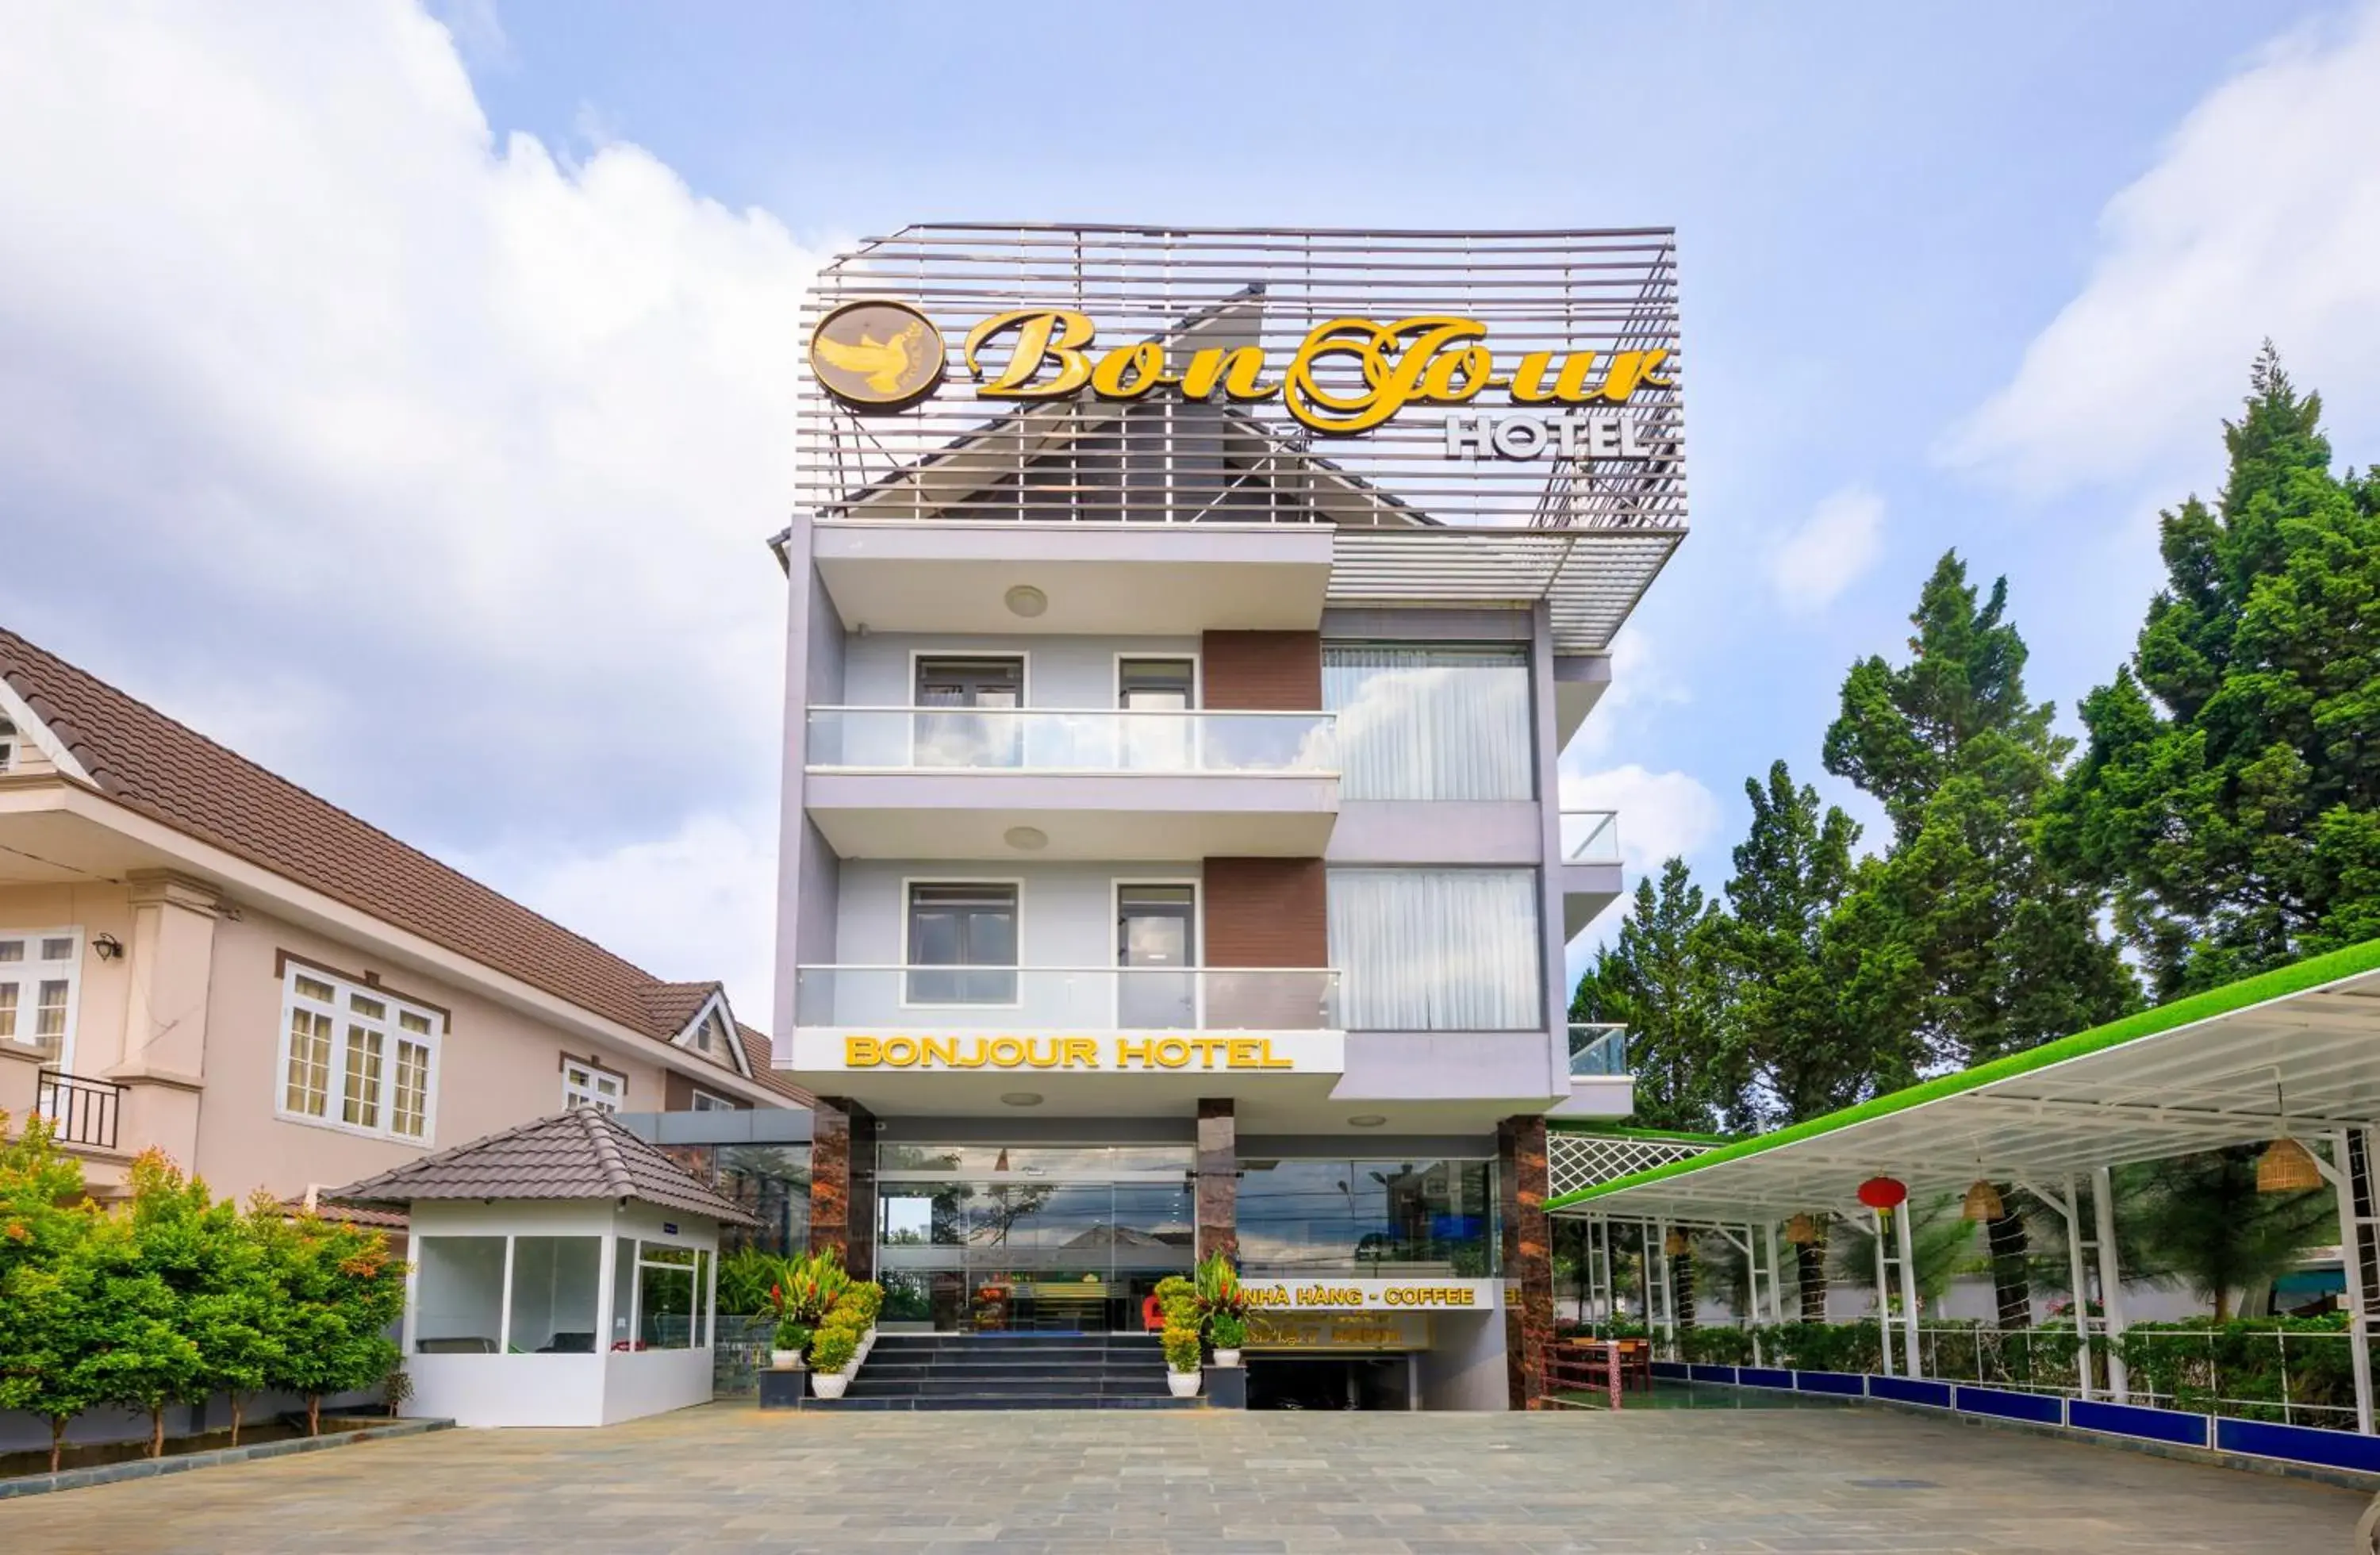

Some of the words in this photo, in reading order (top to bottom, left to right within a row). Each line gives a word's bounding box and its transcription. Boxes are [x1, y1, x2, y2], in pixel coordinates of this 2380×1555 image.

[1445, 415, 1650, 460] HOTEL
[845, 1036, 1099, 1069] BONJOUR
[1116, 1037, 1294, 1069] HOTEL
[1242, 1284, 1291, 1306] NHÀ
[1296, 1284, 1364, 1306] HÀNG
[1384, 1288, 1474, 1306] COFFEE
